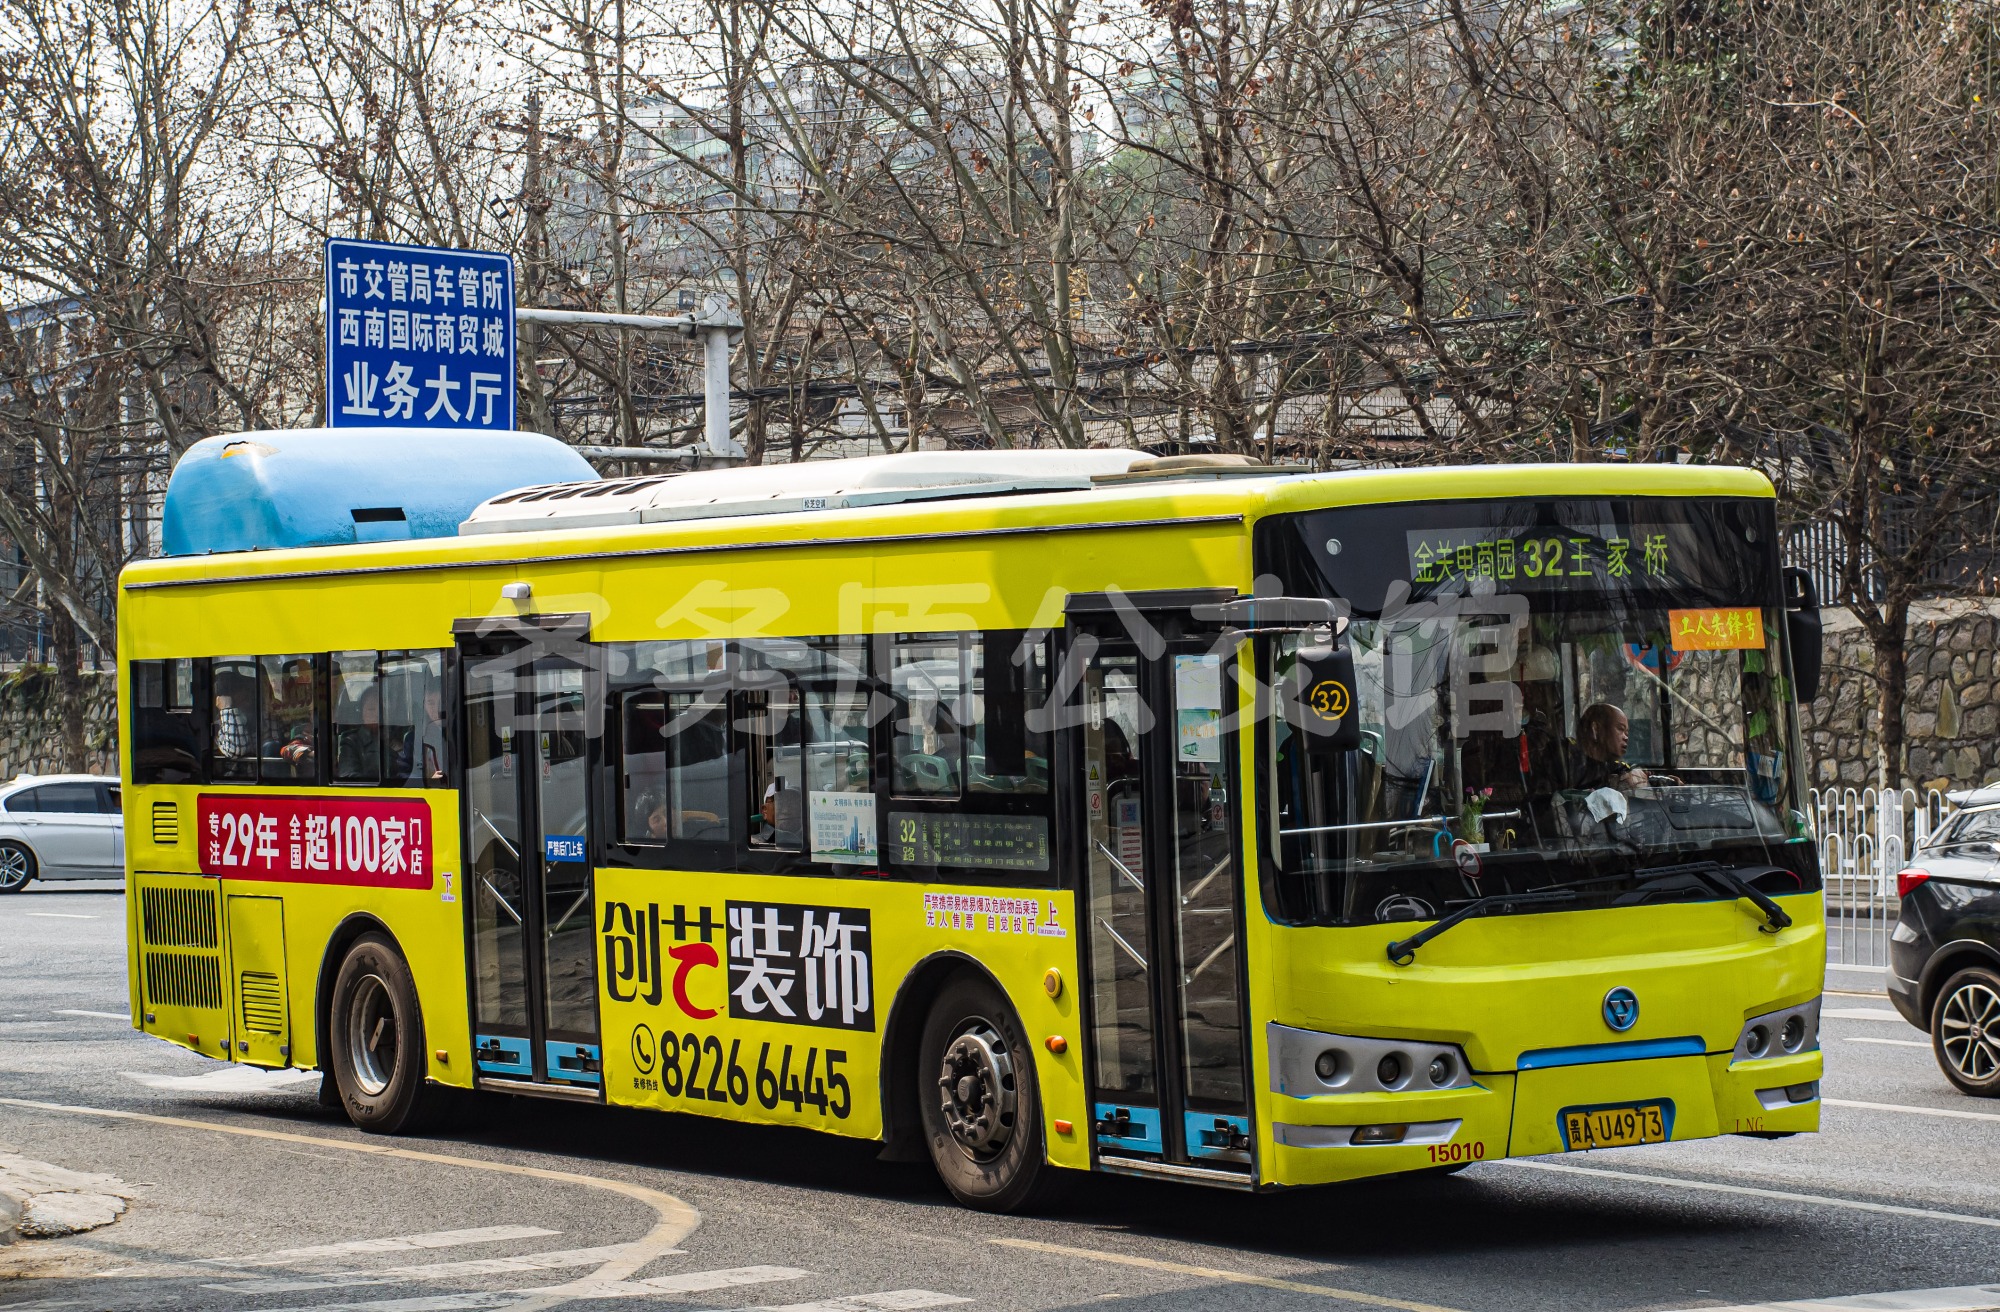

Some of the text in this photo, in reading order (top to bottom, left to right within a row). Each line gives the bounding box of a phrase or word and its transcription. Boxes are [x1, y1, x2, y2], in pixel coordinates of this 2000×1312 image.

[337, 257, 503, 310] 市交管局车管所
[338, 307, 505, 358] 西南国际商贸城
[342, 360, 502, 425] 业务大厅
[1415, 534, 1668, 582] 金关电商园 32 王家桥
[1679, 611, 1756, 641] 工人先锋号
[1317, 689, 1343, 712] 32
[900, 819, 917, 844] 32
[547, 840, 583, 857] 严禁后门上车
[442, 873, 452, 893] 下
[924, 894, 1039, 916] 严禁携带易燃易爆及危险物品乘车
[1046, 901, 1059, 927] 上
[927, 911, 1036, 933] 无人售票 自觉投币
[602, 900, 870, 1025] 创艺装饰
[661, 1030, 851, 1119] 8226 6445
[1427, 1141, 1485, 1163] 15010
